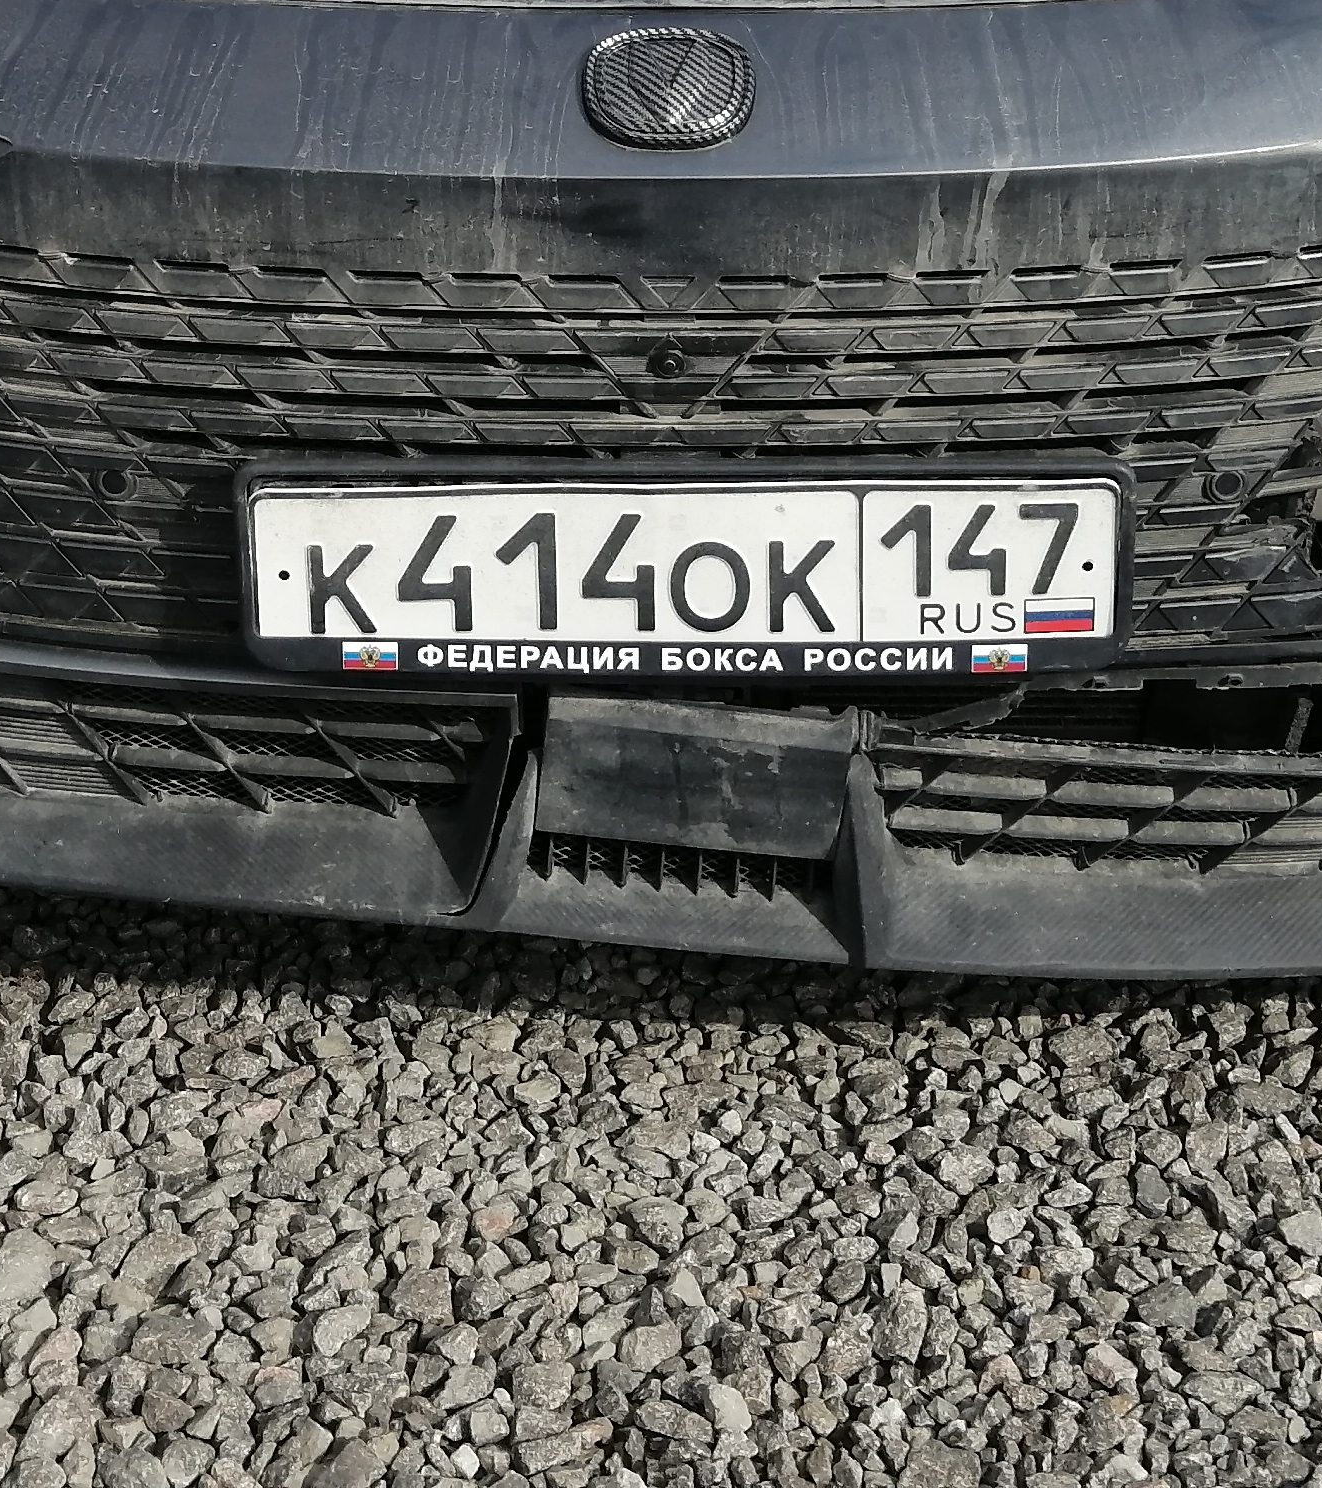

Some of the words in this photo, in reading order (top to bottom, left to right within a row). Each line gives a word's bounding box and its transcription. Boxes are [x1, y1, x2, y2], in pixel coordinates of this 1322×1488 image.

[307, 513, 835, 634] К414ОК
[880, 503, 1079, 598] 147
[920, 602, 1016, 634] RUS
[417, 644, 640, 673] ФЕДЕРАЦИЯ
[661, 646, 784, 674] БОКСА
[804, 646, 954, 672] РОССИИ
